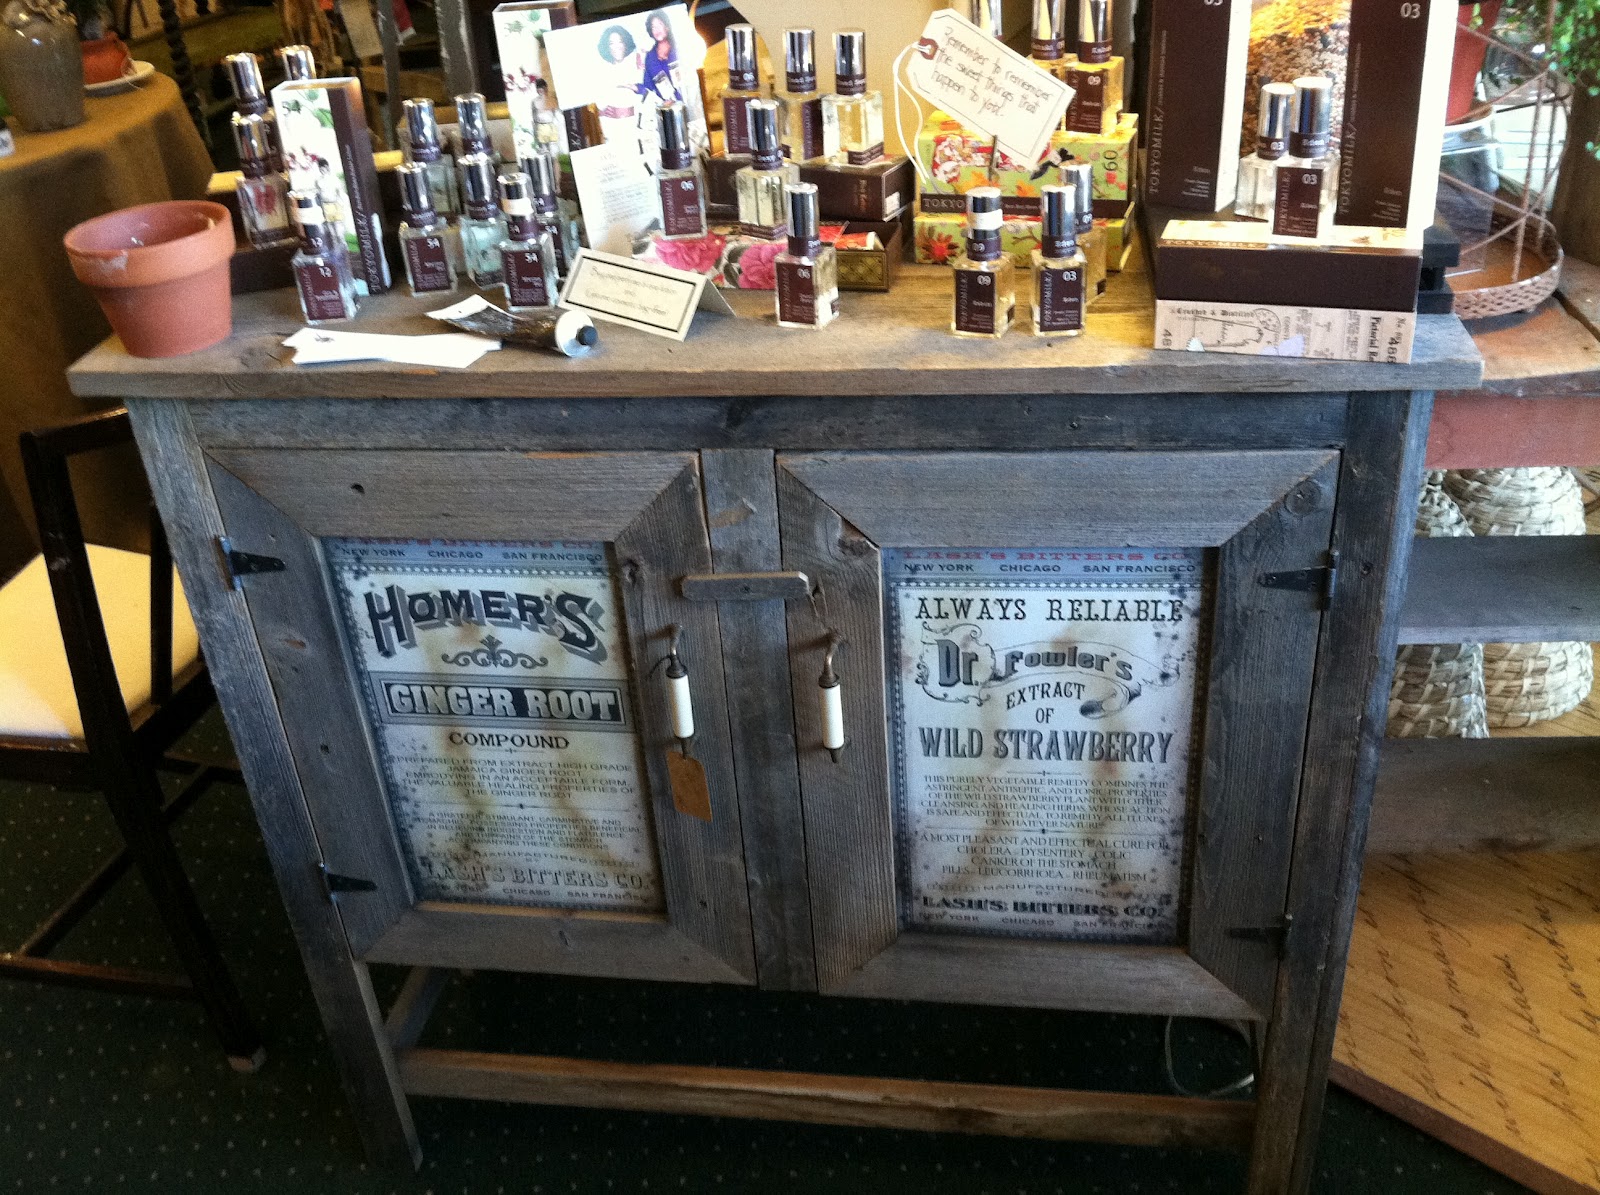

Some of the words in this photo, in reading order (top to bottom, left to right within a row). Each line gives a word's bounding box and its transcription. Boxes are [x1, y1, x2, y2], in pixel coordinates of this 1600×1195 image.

[1400, 2, 1421, 19] 03
[931, 64, 966, 96] happen
[969, 85, 980, 103] to
[991, 57, 1002, 75] to
[1005, 70, 1055, 101] remember
[1087, 75, 1102, 86] 09
[956, 62, 984, 83] sweet
[984, 75, 1014, 109] things
[1018, 93, 1041, 115] that
[1302, 173, 1318, 186] 03
[1062, 270, 1078, 282] 03
[373, 548, 405, 557] YORK
[428, 550, 483, 559] CHICAGO
[502, 551, 528, 560] SAN
[532, 553, 603, 563] FRANCISCO
[1017, 552, 1144, 561] BITTERS
[904, 563, 934, 572] NEW
[939, 564, 975, 572] YORK
[1000, 564, 1061, 572] CHICAGO
[1083, 565, 1111, 573] SAN
[1115, 565, 1196, 573] FRANCISCO
[915, 597, 1027, 620] ALWAYS
[1046, 599, 1184, 622] RELIABLE
[363, 584, 608, 665] HOMER'S
[934, 639, 980, 688] Dr.
[1004, 646, 1132, 681] Fowler's
[388, 685, 517, 718] GINGER
[525, 688, 615, 720] ROOT
[1006, 682, 1086, 710] EXTRACT
[1035, 708, 1055, 724] OF
[449, 731, 570, 750] COMPOUND
[918, 727, 984, 758] WILD
[993, 728, 1174, 763] STRAWBERRY
[447, 765, 498, 775] JAMAICA
[501, 767, 546, 776] GINGER
[463, 758, 498, 767] FROM
[501, 760, 552, 769] EXTRACT
[488, 782, 540, 791] HEALING
[946, 776, 985, 784] PURELY
[986, 776, 1046, 785] VEGETABLE
[1048, 779, 1088, 787] REMEDY
[945, 792, 961, 800] THE
[992, 794, 1060, 802] STRAWBERRY
[920, 800, 979, 808] CLEANSING
[981, 801, 1004, 809] AND
[1005, 802, 1050, 810] HEALING
[1001, 819, 1059, 828] WHATEVER
[1060, 813, 1101, 821] REMEDY
[920, 833, 929, 842] A
[930, 833, 960, 842] MOST
[962, 834, 1019, 845] PLEASANT
[1021, 836, 1047, 846] AND
[1048, 838, 1112, 848] EFFECTUAL
[1113, 840, 1145, 849] CURE
[957, 845, 1012, 855] CHOLERA
[1020, 847, 1085, 858] DYSENTERY
[1094, 850, 1132, 860] COLIC
[971, 856, 1019, 866] CANKER
[1020, 858, 1035, 867] OF
[1037, 858, 1059, 868] THE
[1059, 859, 1117, 869] STOMACH
[512, 867, 608, 889] BITTERS
[942, 865, 970, 875] PILES
[1073, 871, 1147, 881] RHEUMATISM
